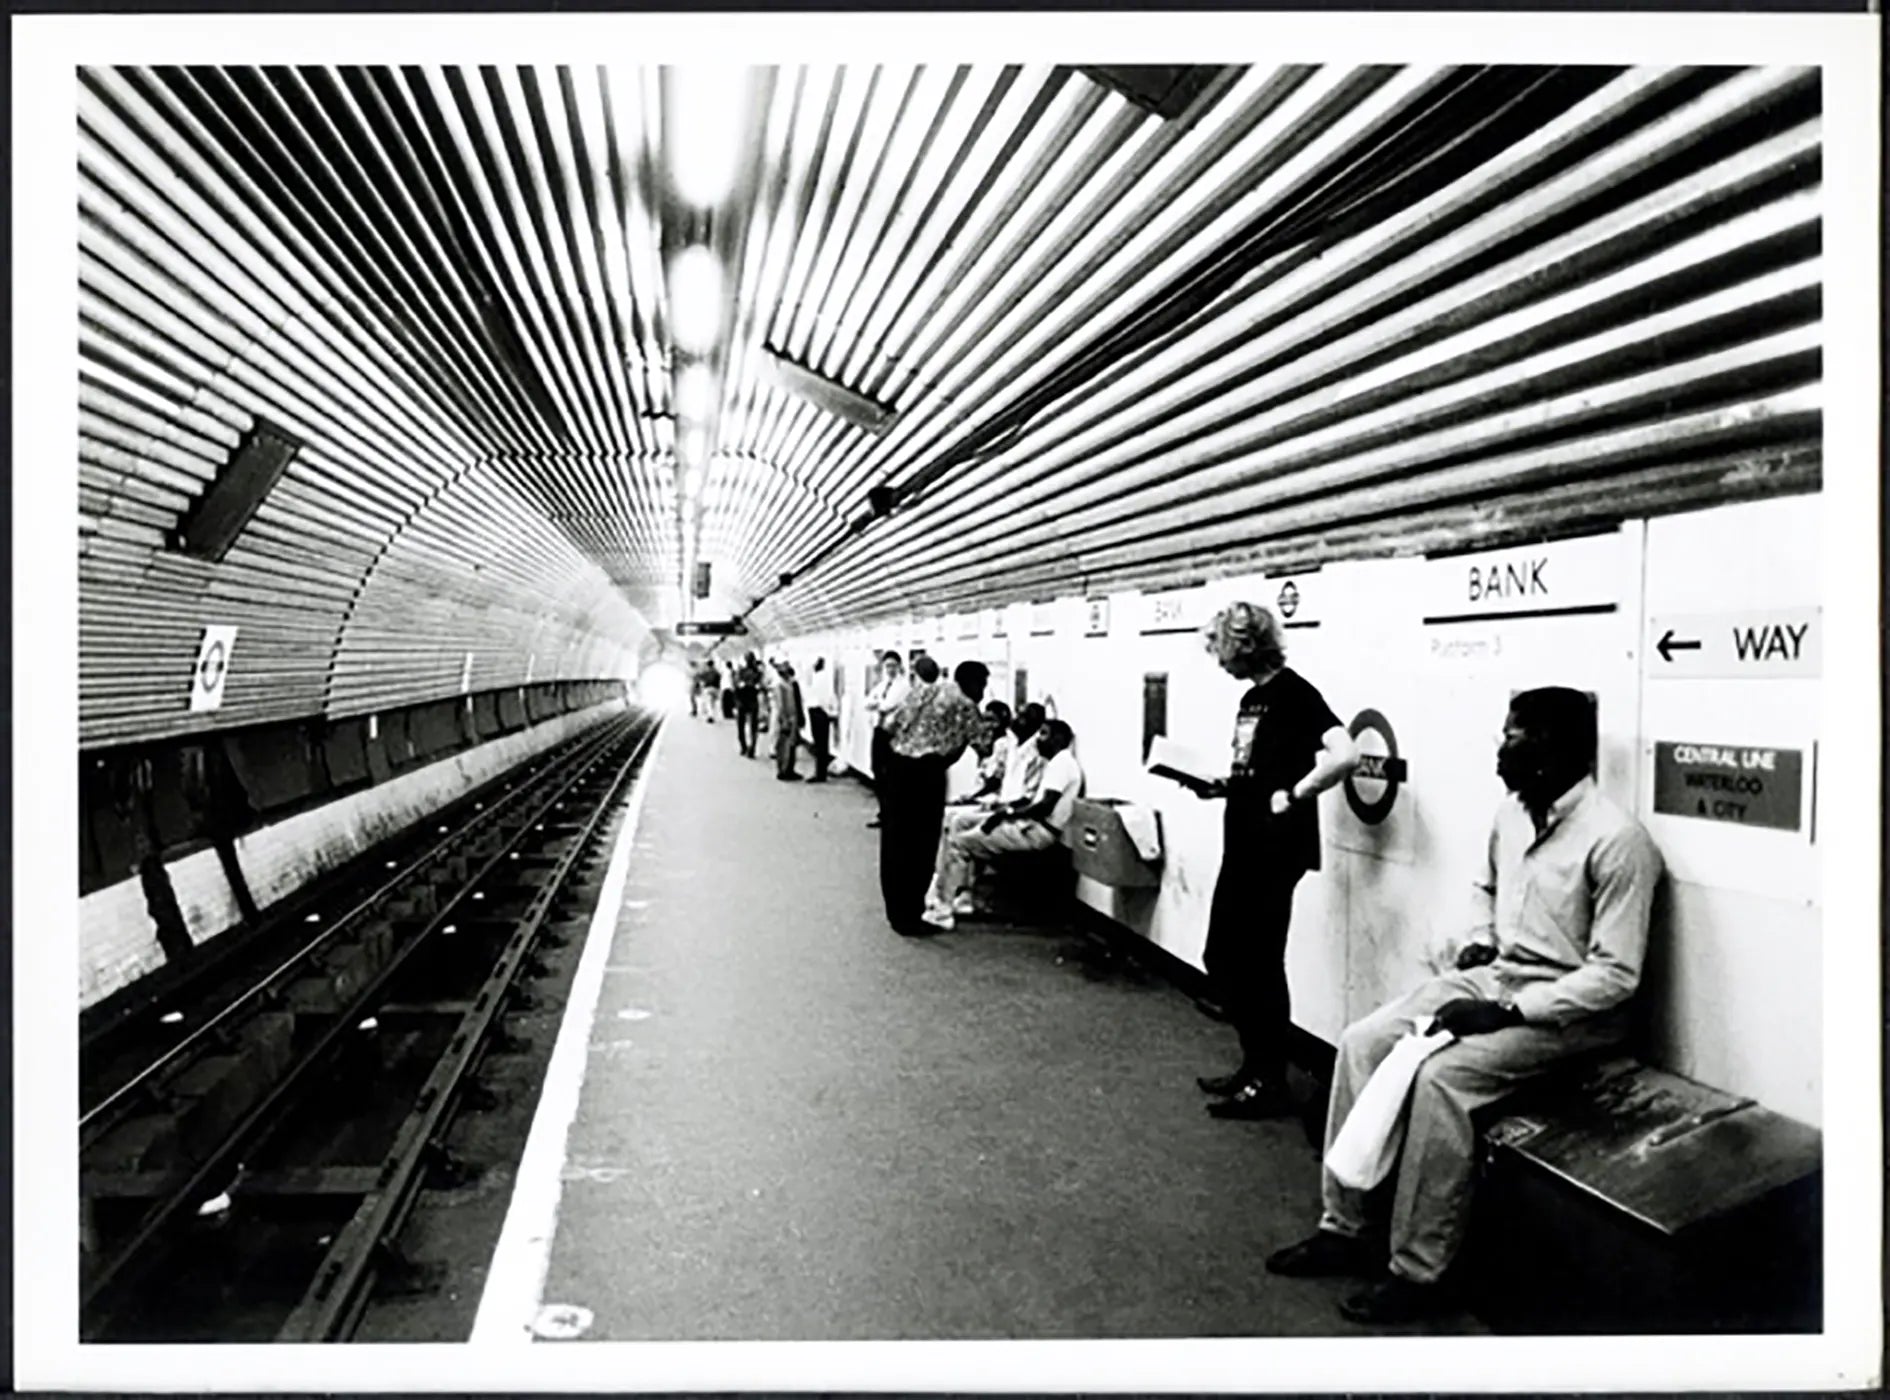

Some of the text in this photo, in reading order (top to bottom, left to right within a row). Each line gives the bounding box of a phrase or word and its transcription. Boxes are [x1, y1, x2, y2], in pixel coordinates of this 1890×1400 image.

[1469, 556, 1548, 602] BANK
[1733, 622, 1808, 661] WAY
[1673, 744, 1777, 771] CENTRAL LINE
[1683, 772, 1764, 796] WATERLOO
[1713, 799, 1748, 820] CITY
